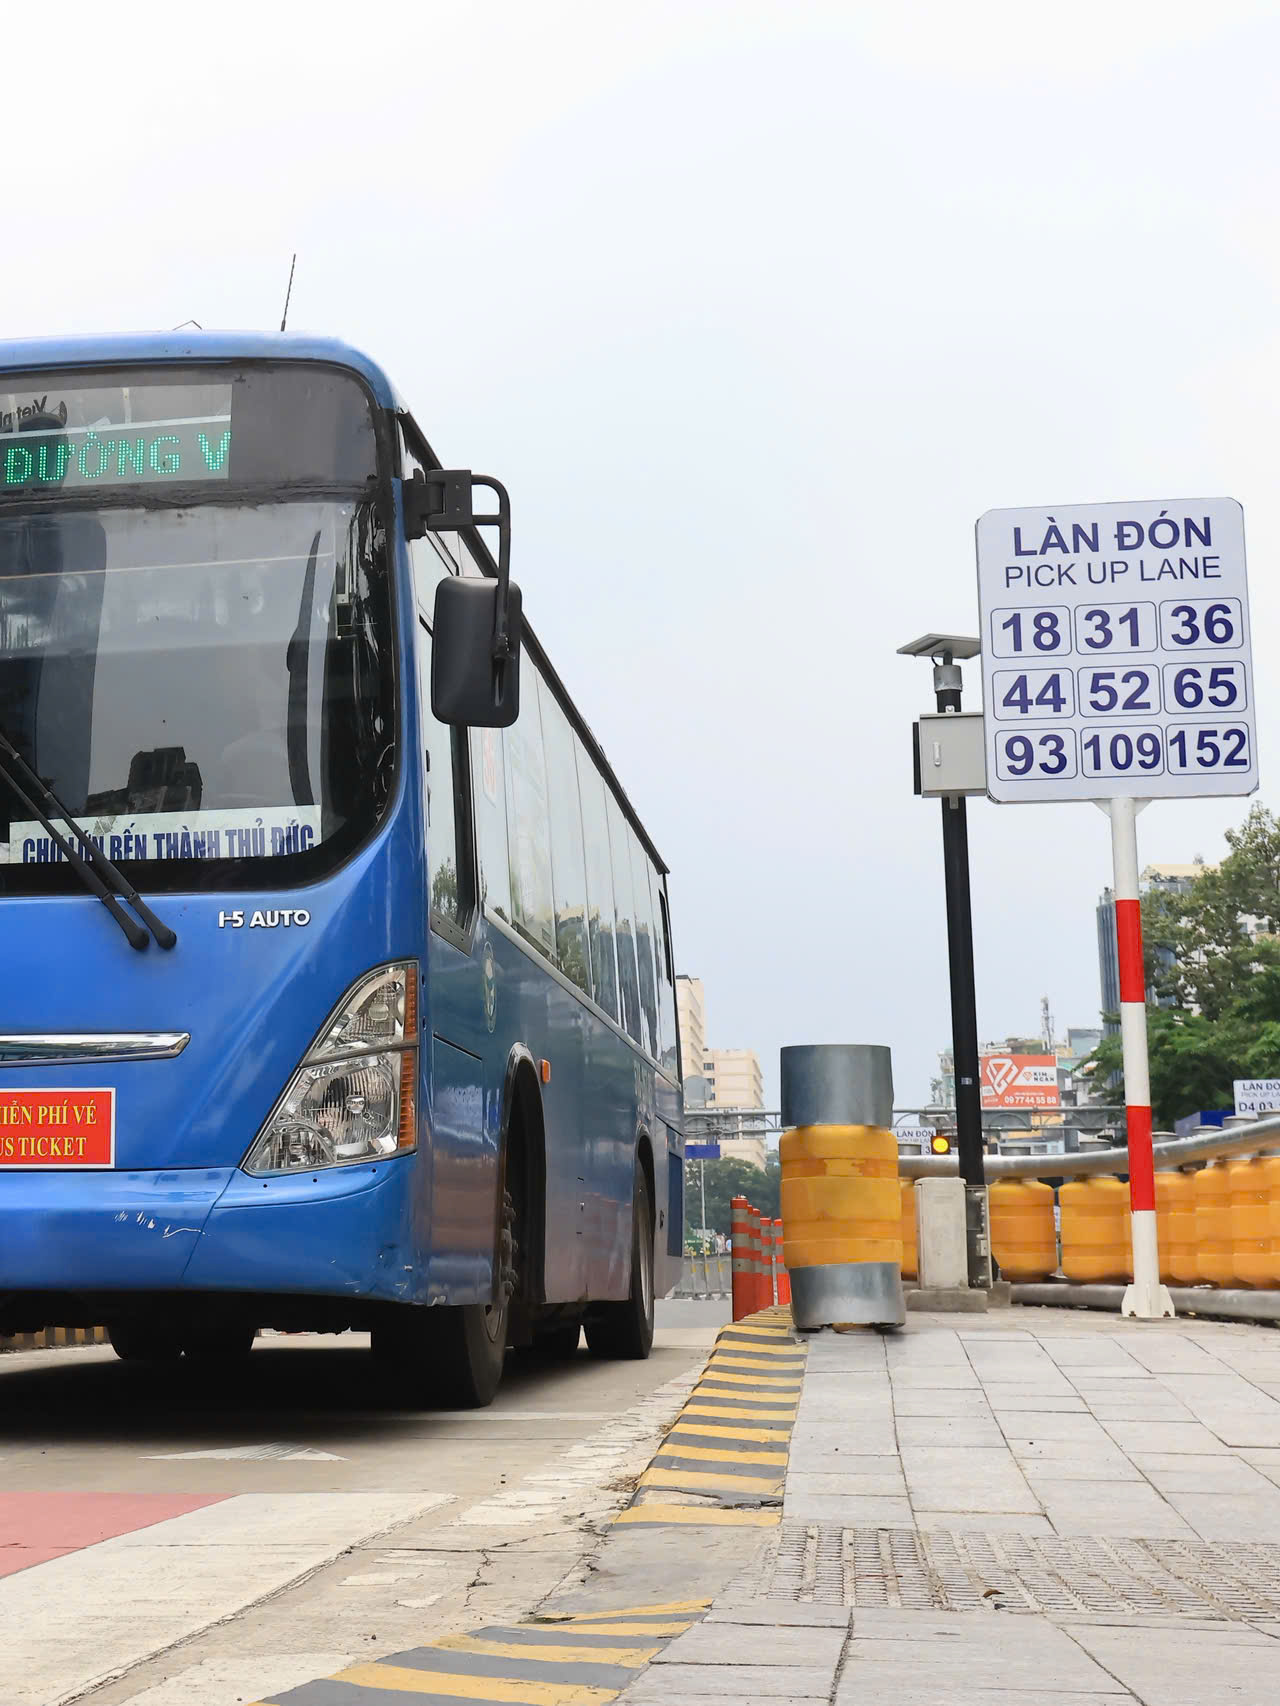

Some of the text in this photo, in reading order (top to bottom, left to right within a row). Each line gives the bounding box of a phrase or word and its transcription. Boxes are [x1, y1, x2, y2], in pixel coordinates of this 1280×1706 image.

[4, 431, 181, 484] ĐƯỜNG
[1013, 510, 1212, 557] LÀN ĐÓN
[1005, 556, 1222, 588] PICK UP LANE
[1002, 604, 1234, 652] 18 31 36
[1002, 667, 1238, 714] 44 52 65
[1005, 728, 1248, 775] 93 109 152
[110, 822, 148, 860] BẾN
[154, 825, 220, 860] THÀNH
[225, 817, 265, 857] THỦ
[270, 818, 314, 857] ĐỨC
[249, 909, 311, 928] AUTO
[38, 1099, 68, 1125] PHÍ
[74, 1099, 97, 1125] VÉ
[17, 1136, 87, 1157] TICKET
